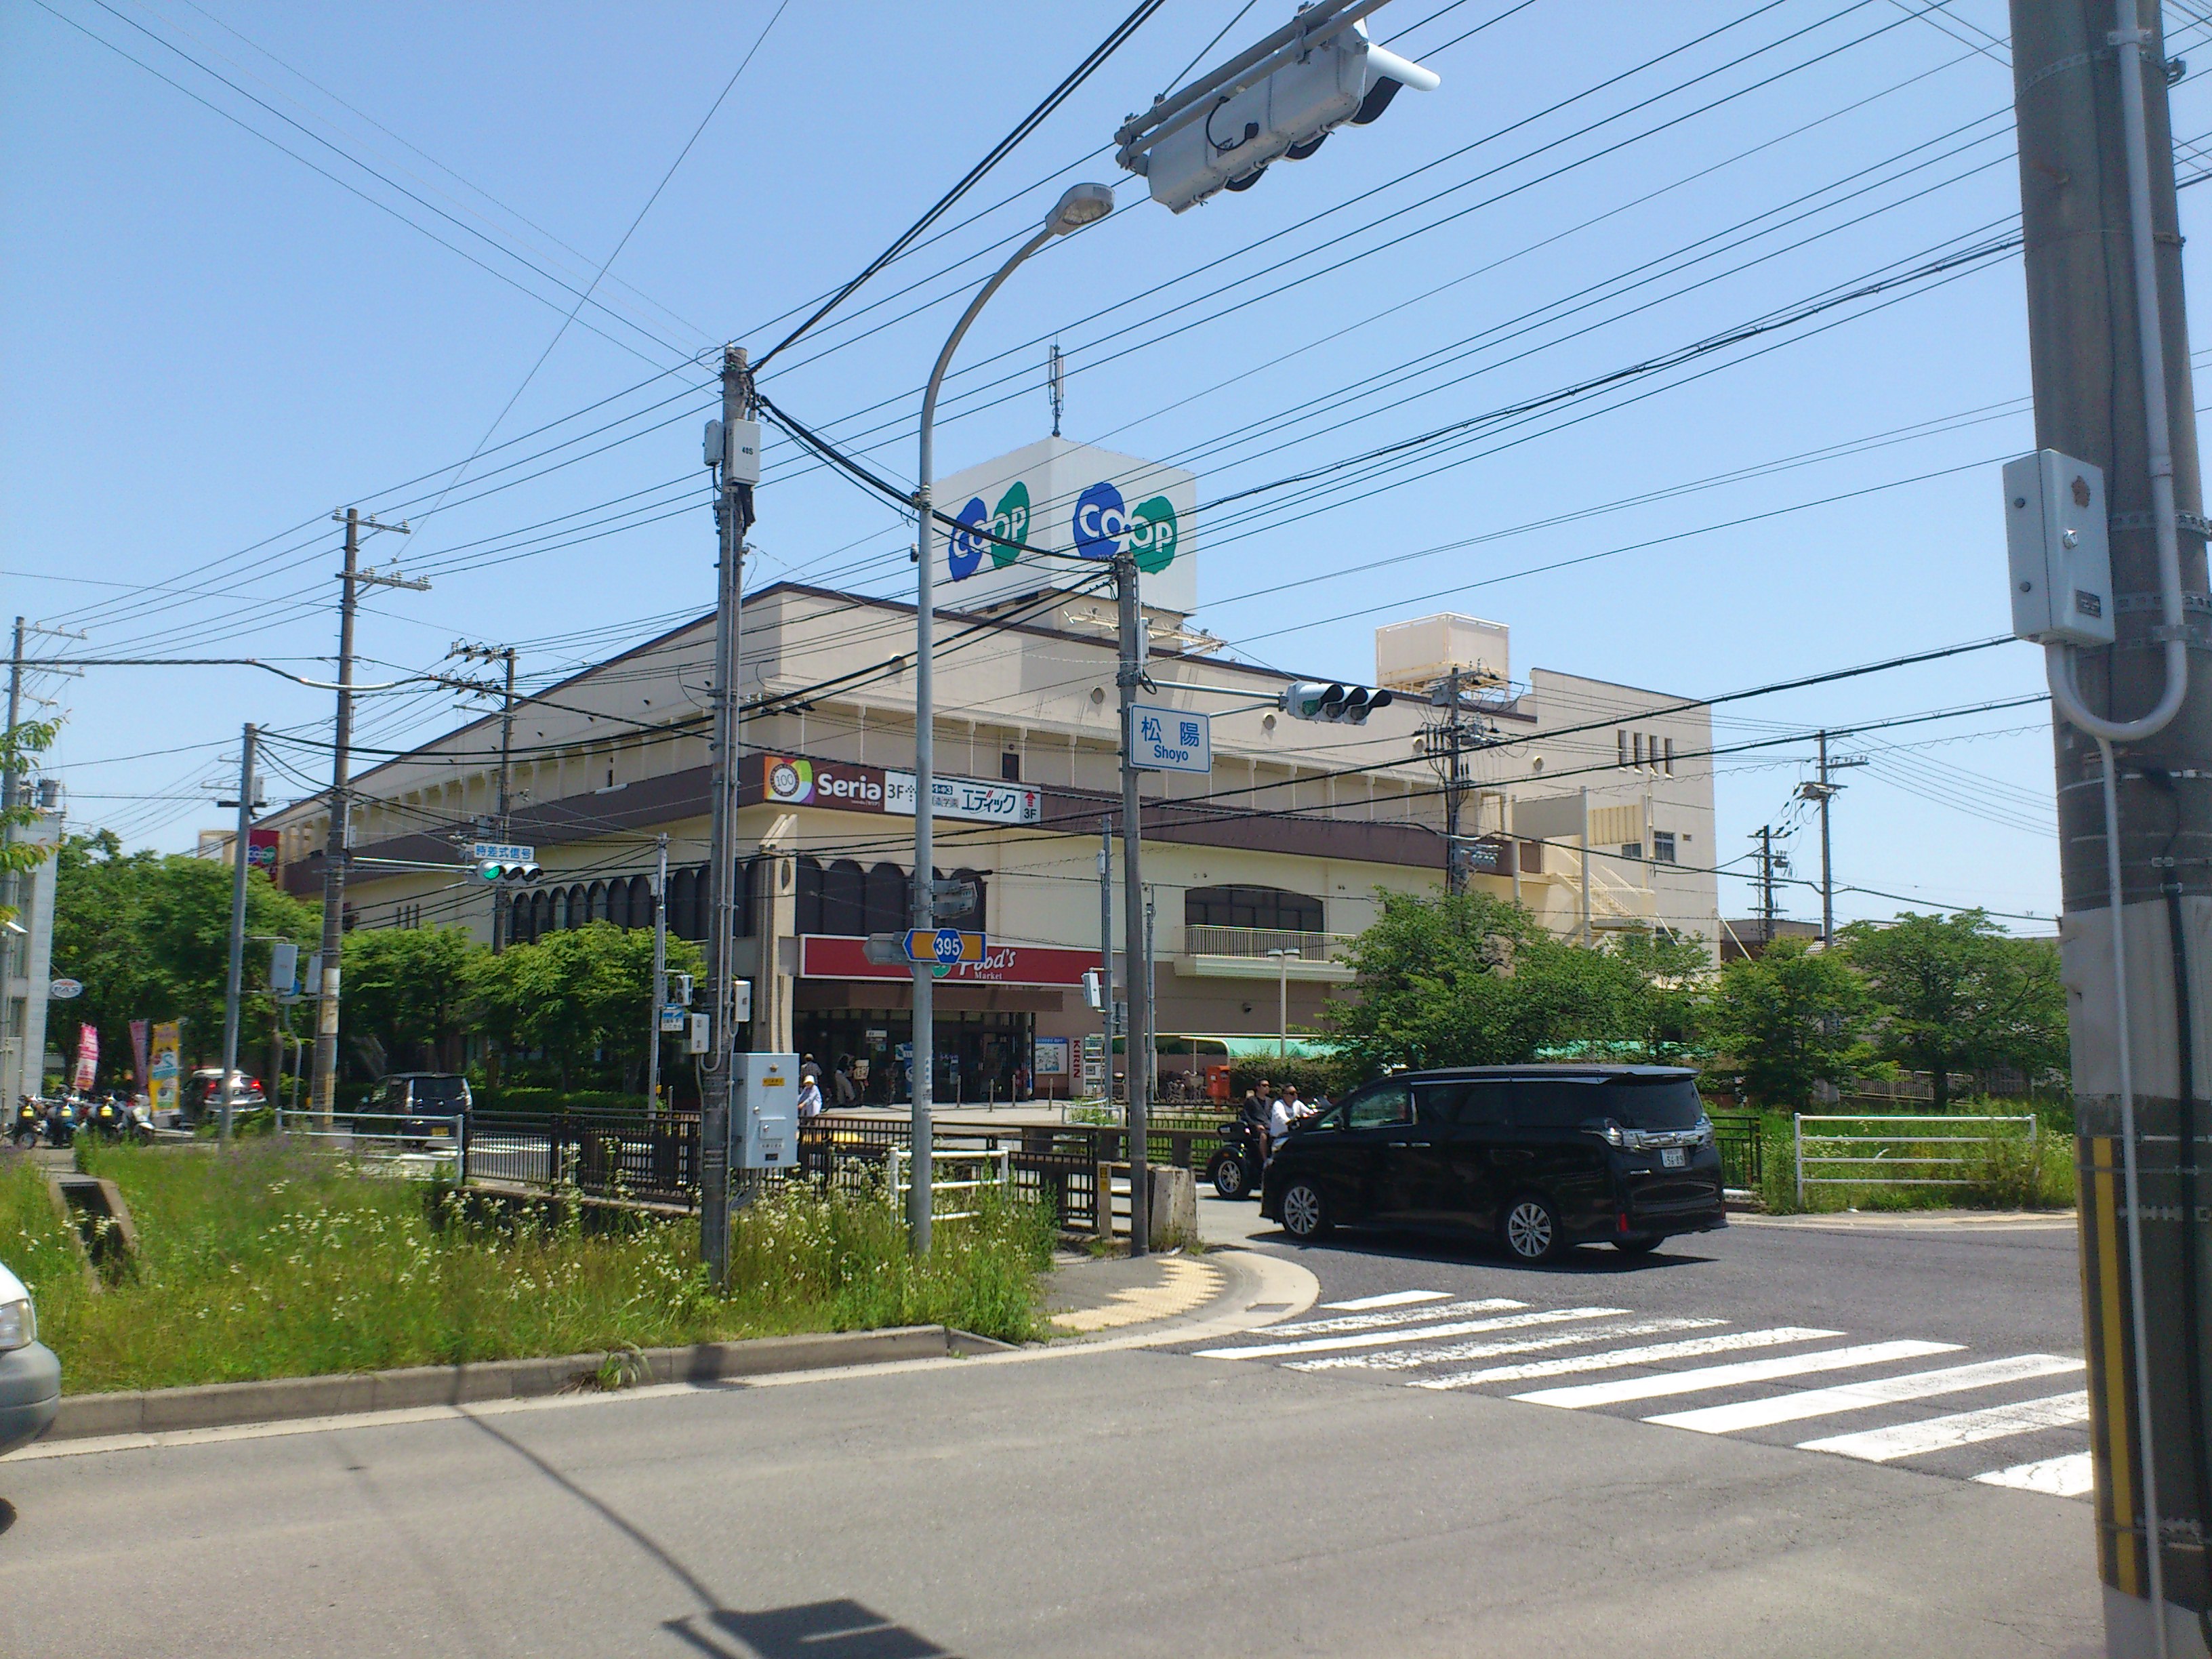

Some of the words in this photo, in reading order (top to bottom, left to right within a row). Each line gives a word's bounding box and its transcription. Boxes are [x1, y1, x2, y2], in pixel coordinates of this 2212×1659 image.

[1141, 716, 1200, 747] 松陽
[1154, 744, 1189, 762] Shoyo
[776, 774, 793, 787] 100
[818, 773, 881, 800] Seria
[888, 784, 903, 799] 3F
[962, 790, 1016, 814] エディック
[1024, 808, 1037, 819] 3F
[476, 845, 531, 859] 時差式信号
[935, 937, 960, 956] 395
[975, 971, 1002, 980] Market
